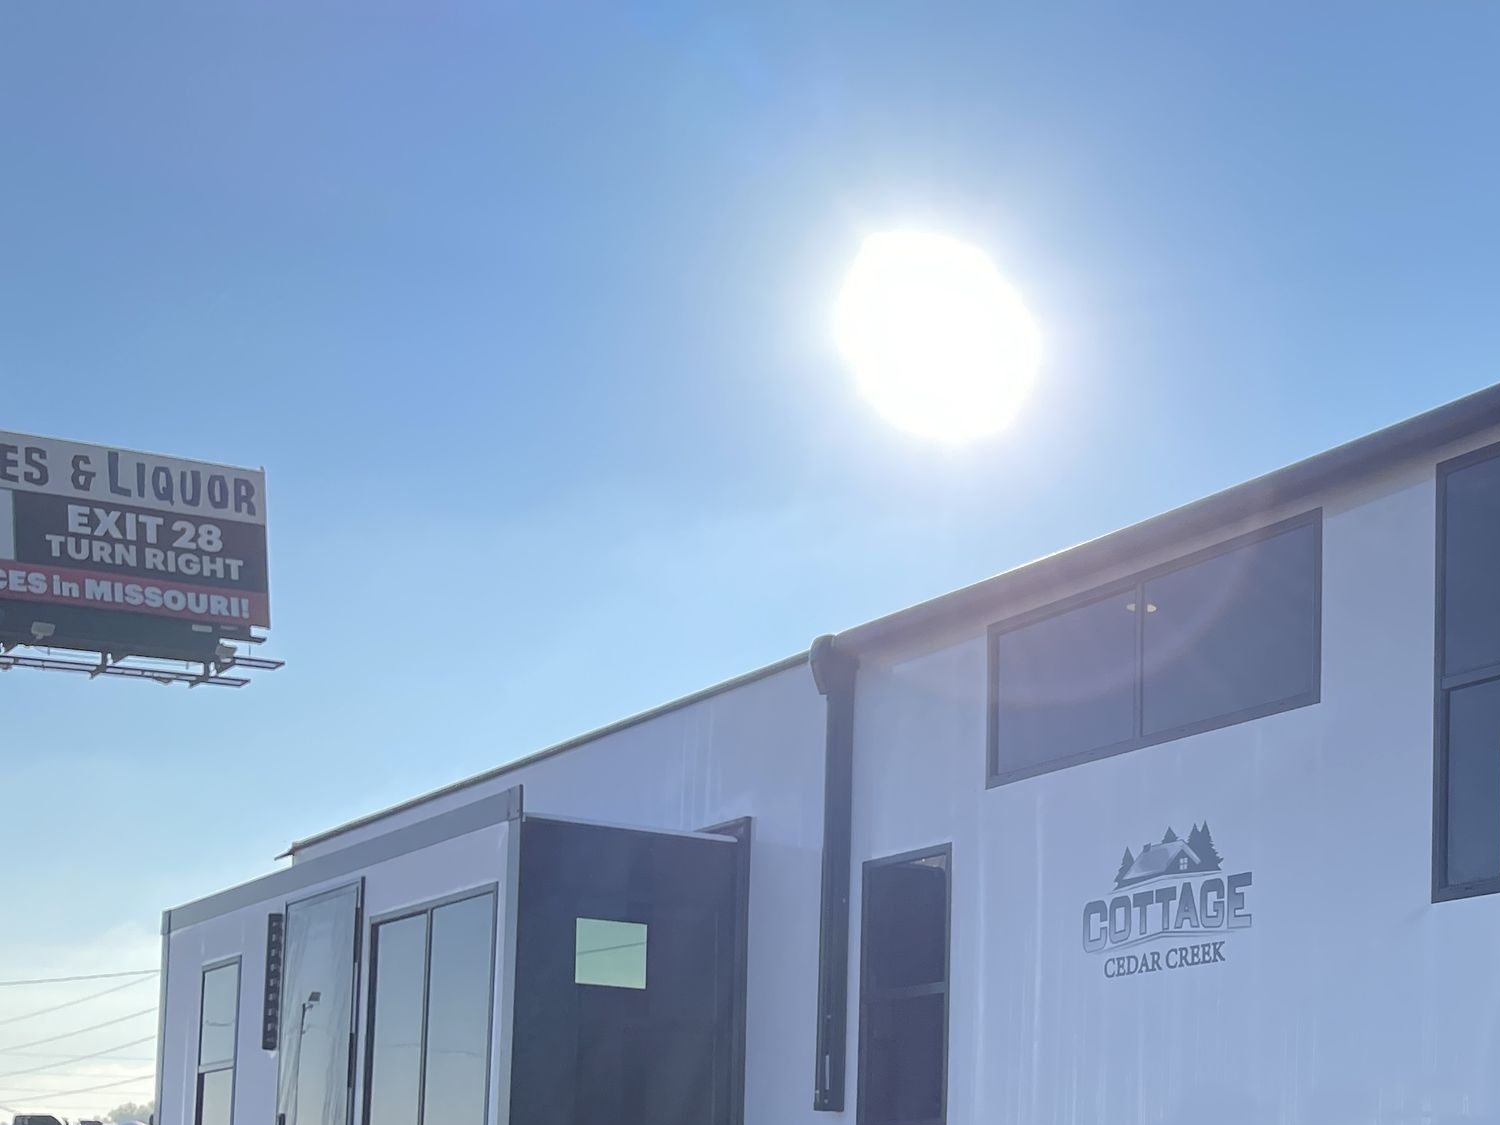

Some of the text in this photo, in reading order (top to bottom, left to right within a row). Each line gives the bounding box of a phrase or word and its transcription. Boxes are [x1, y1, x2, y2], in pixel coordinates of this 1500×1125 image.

[0, 443, 256, 516] ES & LIQUOR
[67, 504, 223, 553] EXIT 28
[45, 534, 243, 580] TURN RIGHT
[53, 575, 79, 598] in
[85, 578, 249, 619] MISSOURI!
[1082, 871, 1252, 953] COTTAGE
[1104, 941, 1225, 978] CEDAR CREEK
